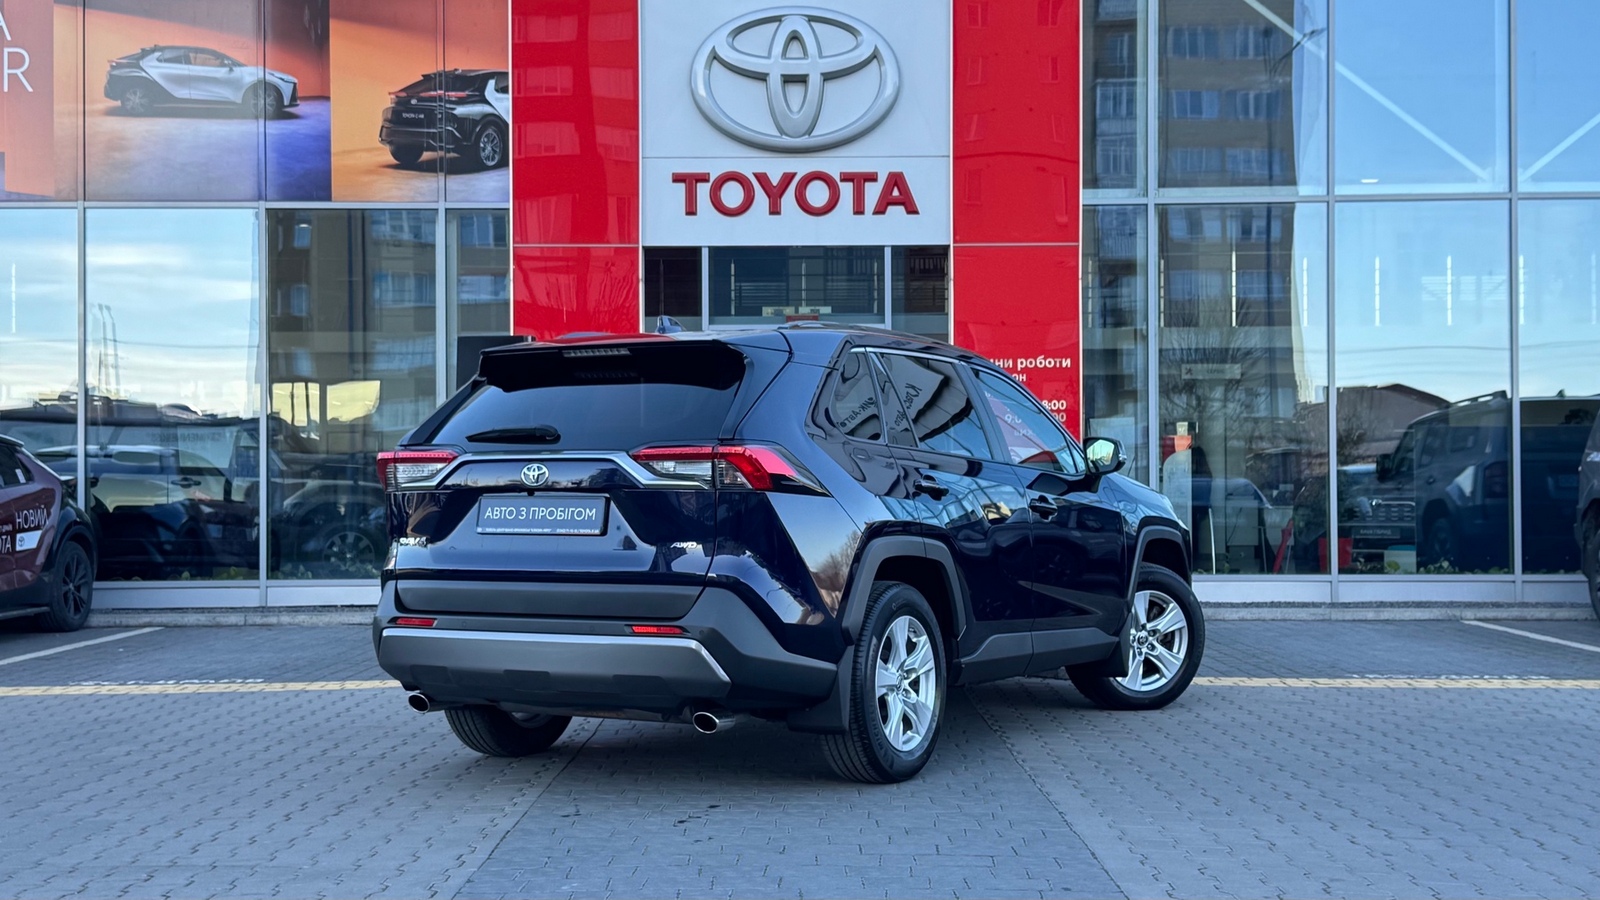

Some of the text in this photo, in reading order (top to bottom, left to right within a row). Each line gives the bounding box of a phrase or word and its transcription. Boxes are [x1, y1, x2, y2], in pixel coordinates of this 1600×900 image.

[671, 170, 921, 218] TOYOTA
[990, 355, 1071, 371] ни роботи
[15, 504, 48, 529] НОВИЙ
[484, 507, 597, 521] АВТО З ПРОБІГОМ
[670, 541, 698, 549] AWD
